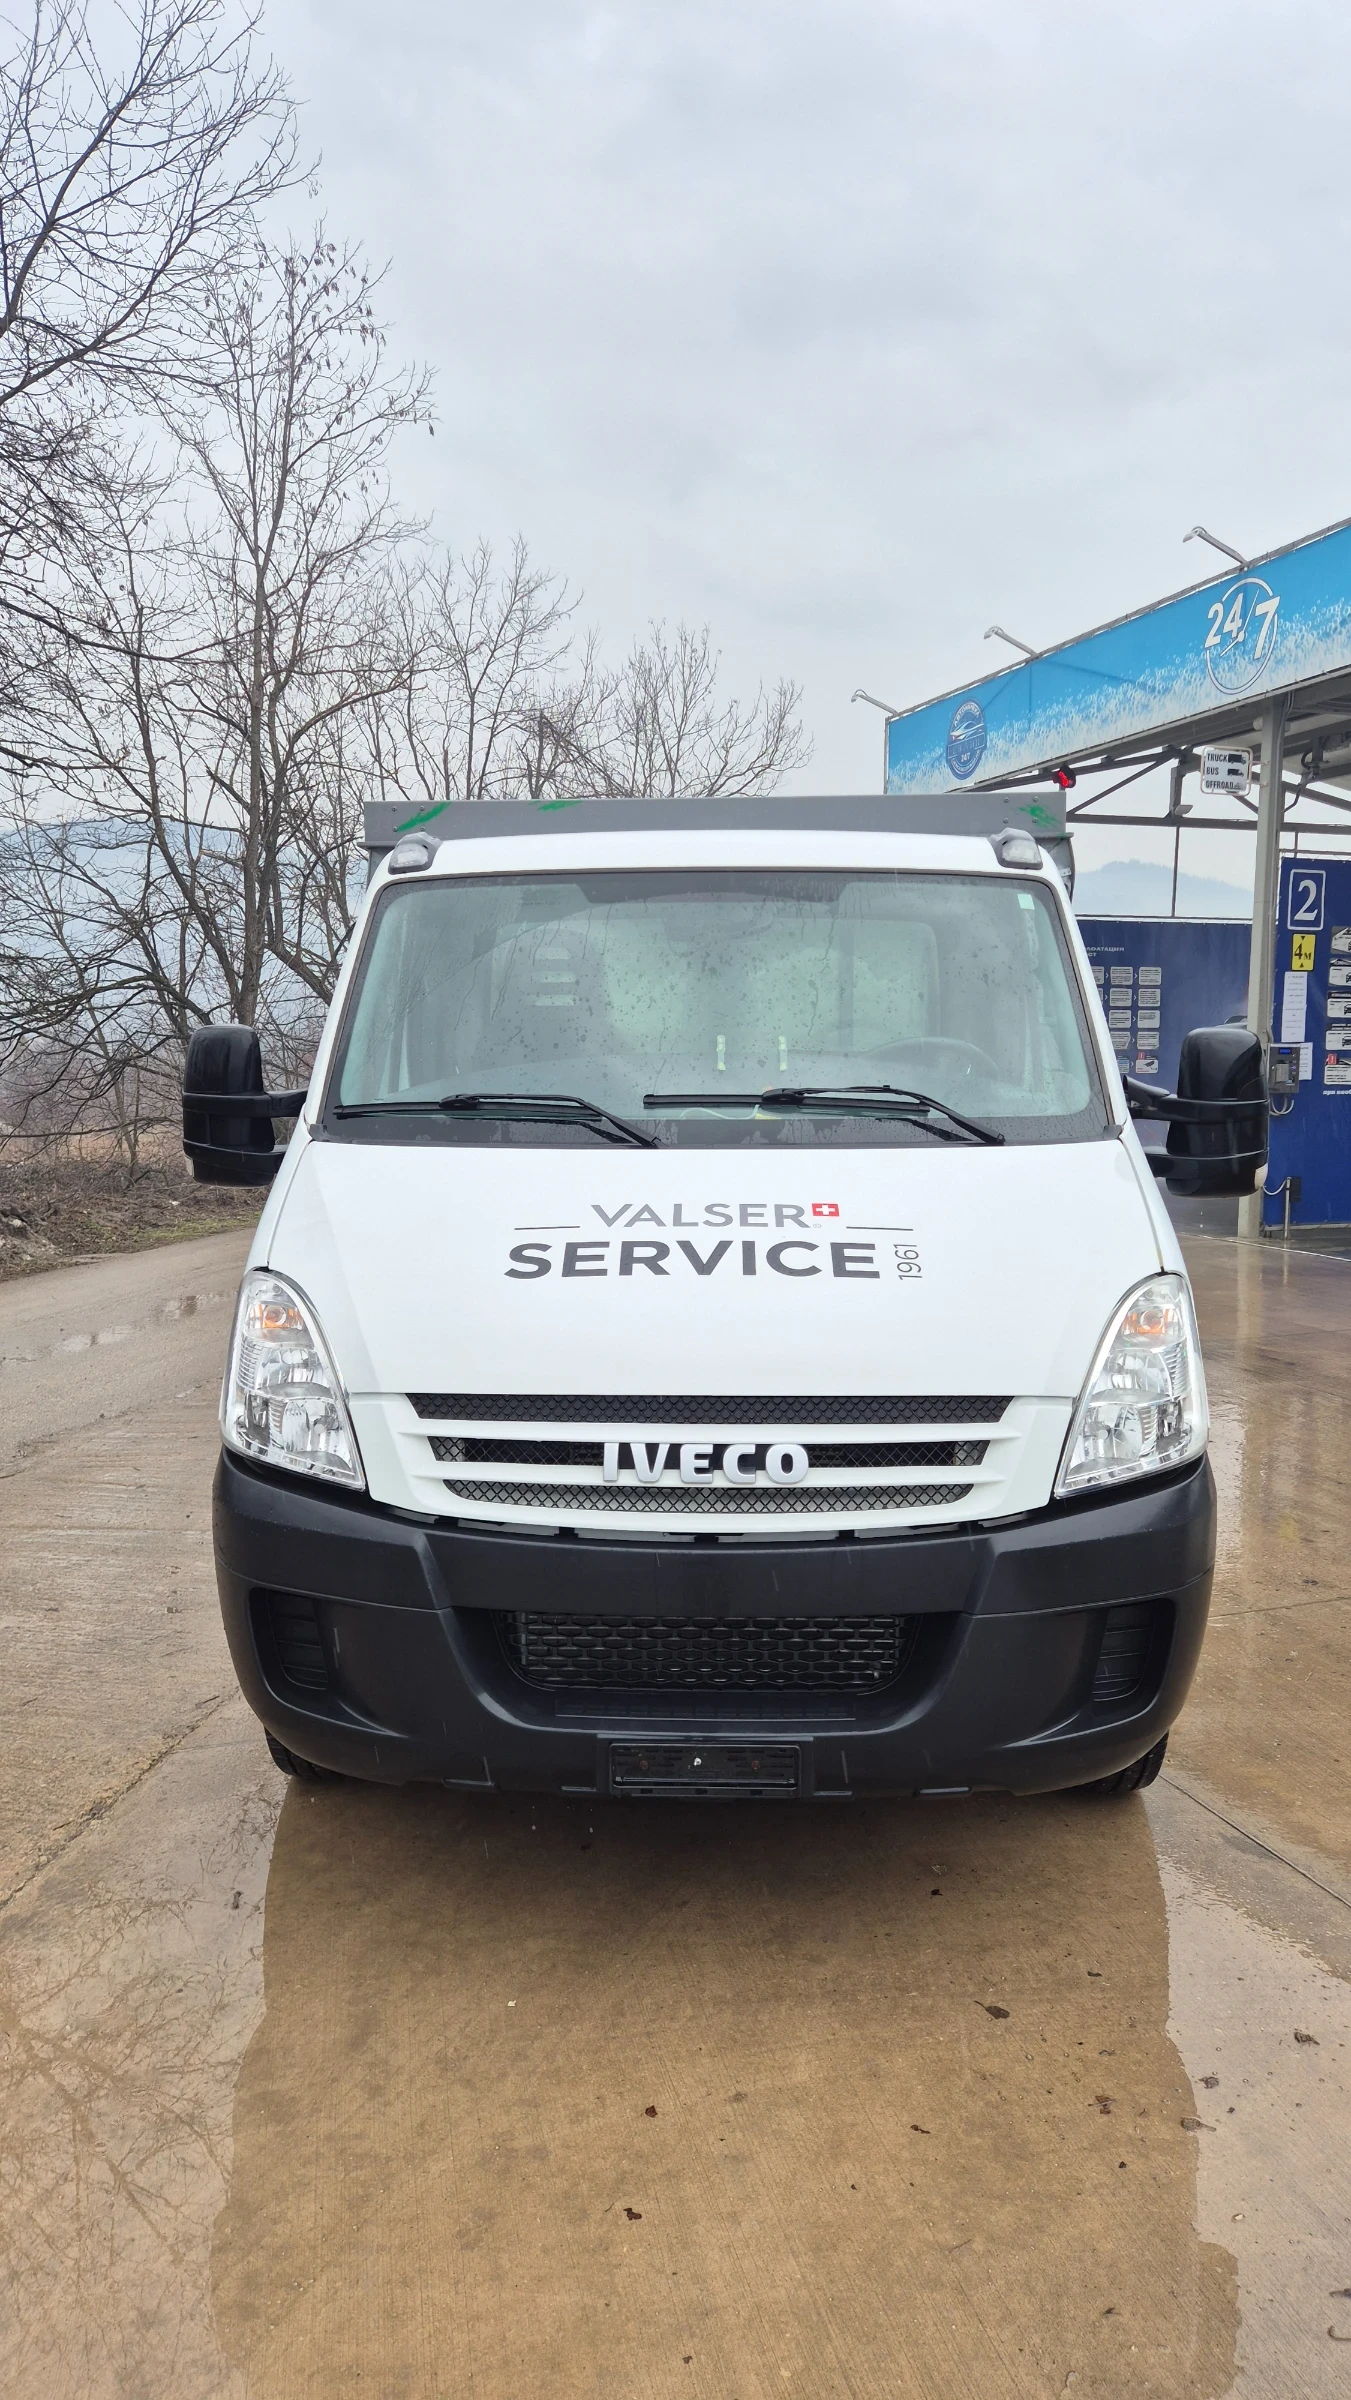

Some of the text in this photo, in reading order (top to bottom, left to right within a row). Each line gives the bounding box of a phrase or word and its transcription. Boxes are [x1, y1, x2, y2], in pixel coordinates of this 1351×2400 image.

[1207, 753, 1228, 763] TRUCK
[1206, 766, 1219, 776] BUS
[1206, 780, 1234, 789] OFFROAD
[1293, 879, 1319, 920] 2
[590, 1203, 812, 1228] VALSER
[503, 1240, 923, 1281] SERVICE 1961
[602, 1442, 810, 1485] IVECO
